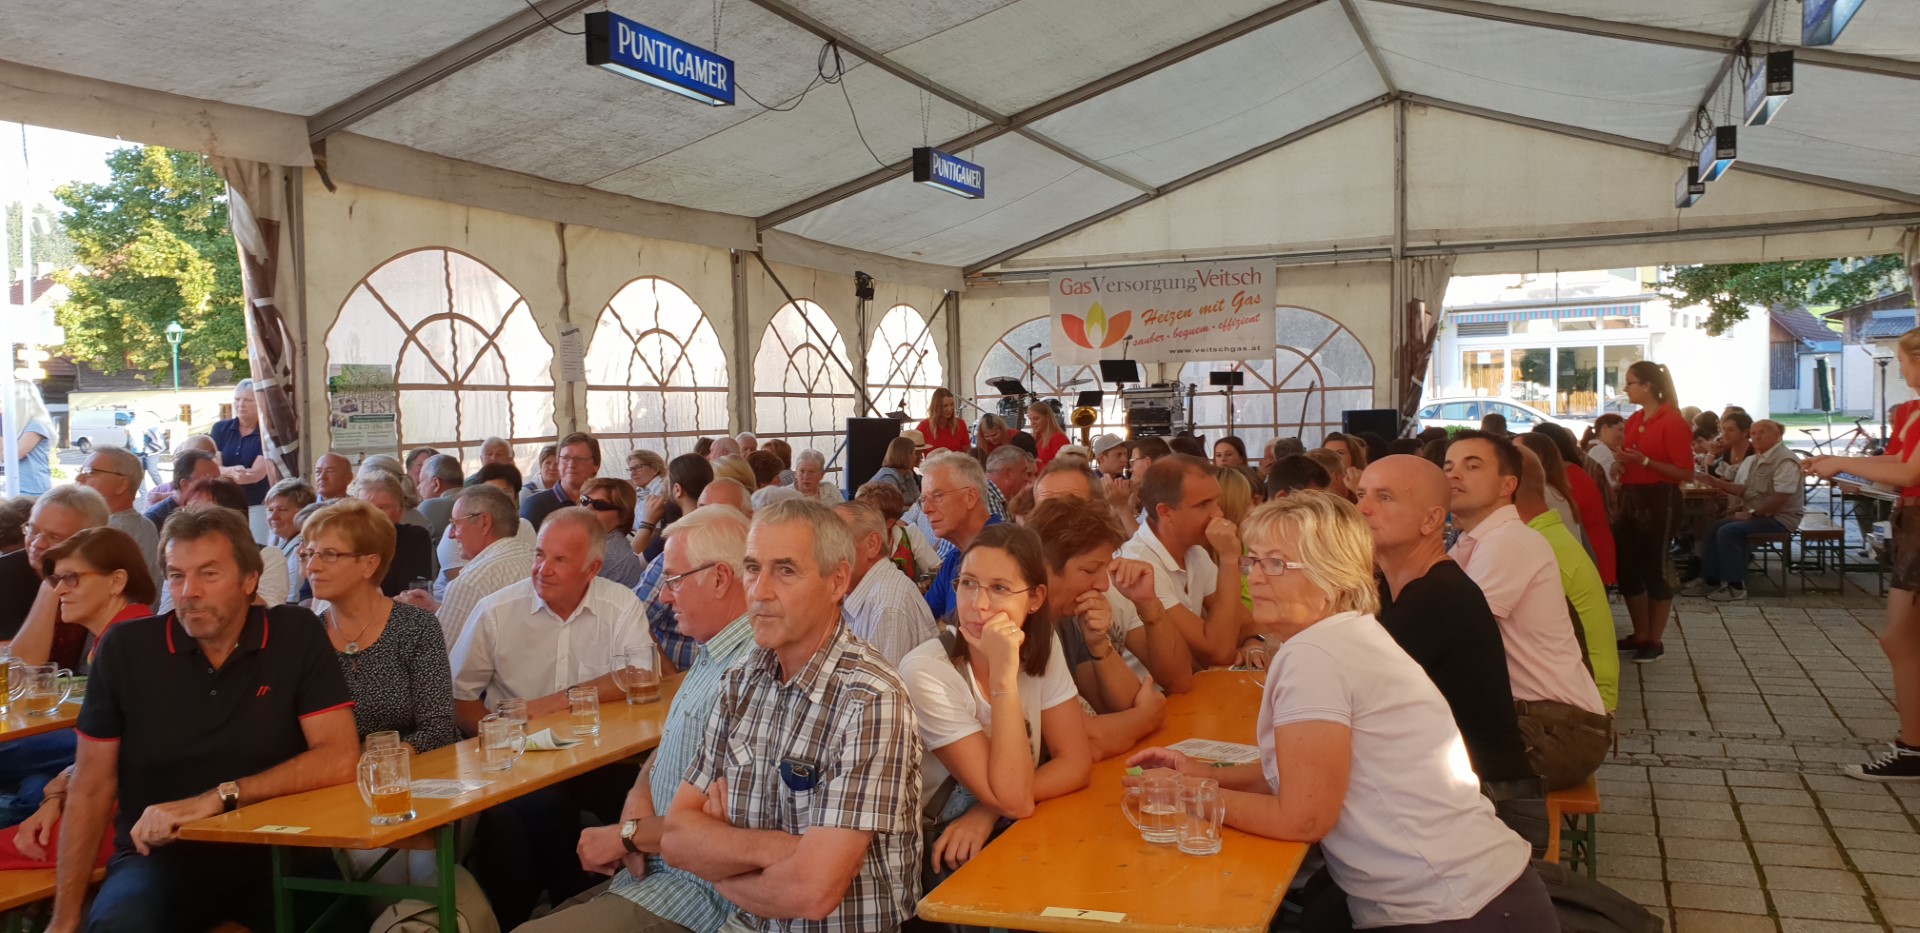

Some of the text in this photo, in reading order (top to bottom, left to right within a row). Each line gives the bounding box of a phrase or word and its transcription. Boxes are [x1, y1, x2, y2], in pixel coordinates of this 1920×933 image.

[617, 22, 728, 92] PUNTIGAMER
[932, 153, 982, 190] PUNTIGAMER
[1141, 290, 1262, 327] Heizen mit Gas
[1133, 313, 1261, 347] sauber bequem effizient
[1168, 345, 1262, 354] www.veitschgas.at
